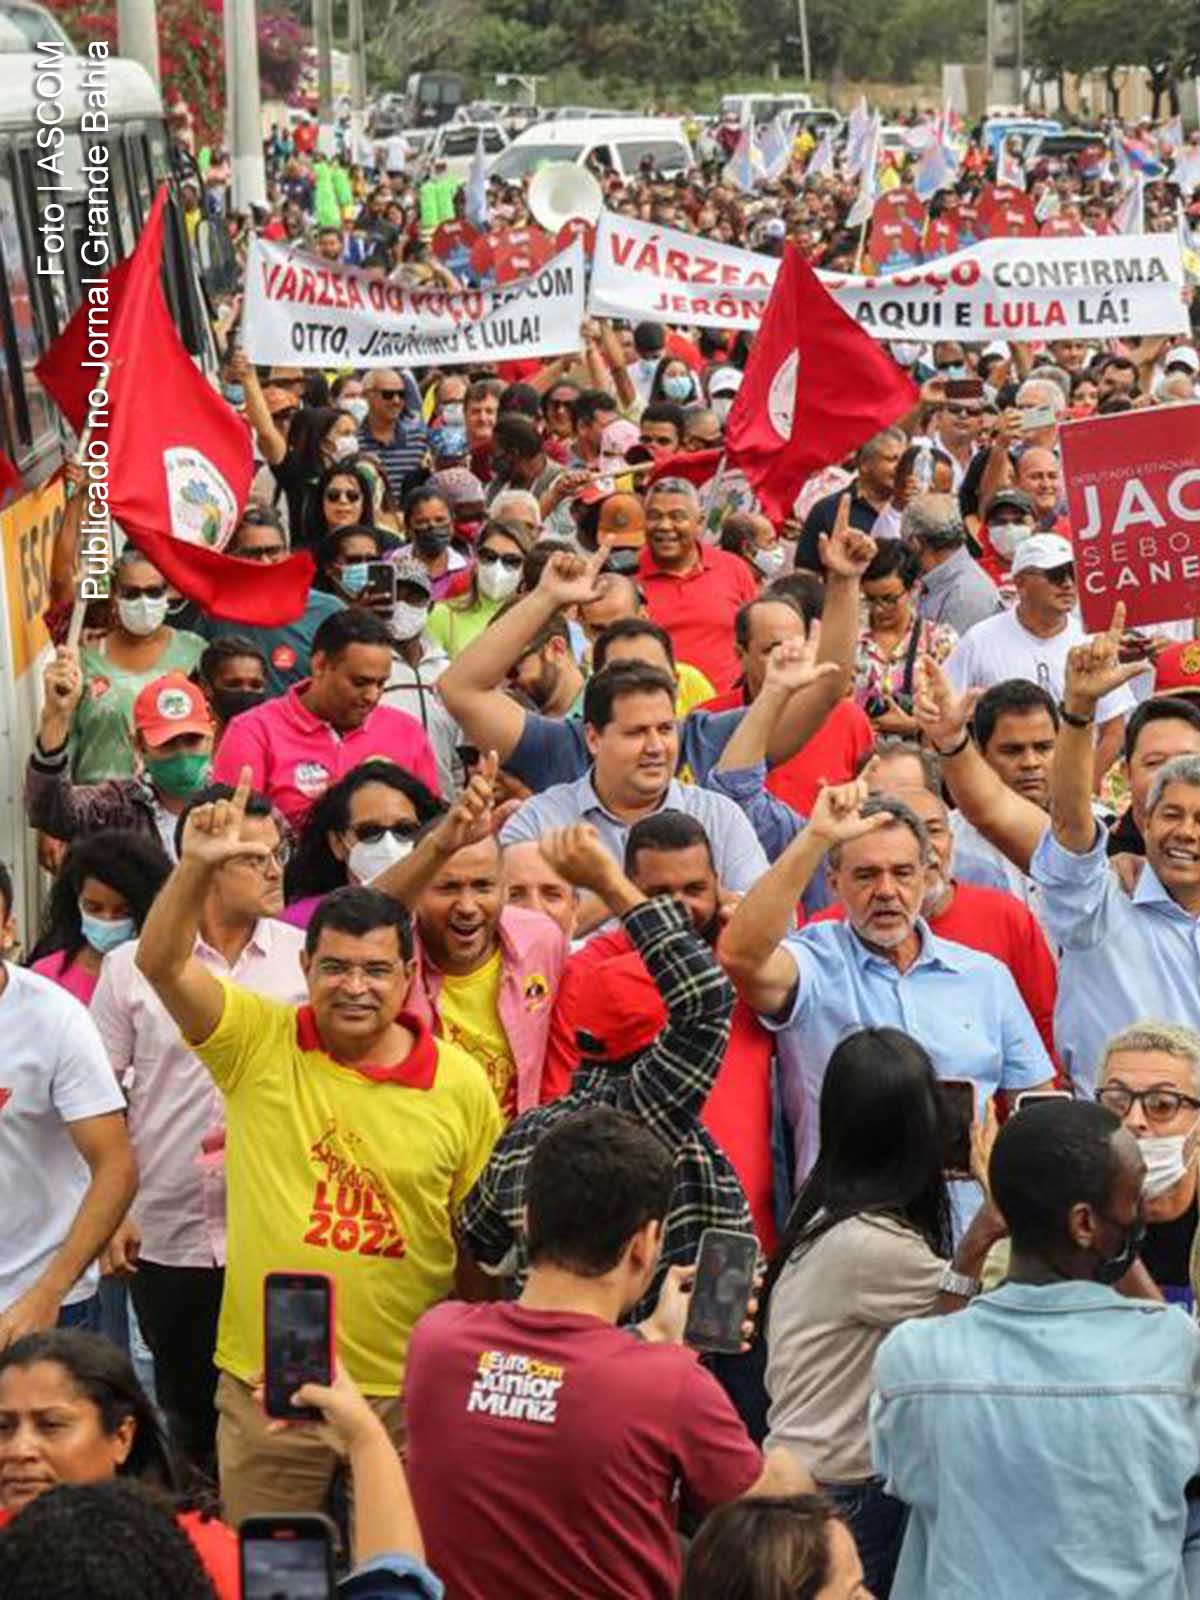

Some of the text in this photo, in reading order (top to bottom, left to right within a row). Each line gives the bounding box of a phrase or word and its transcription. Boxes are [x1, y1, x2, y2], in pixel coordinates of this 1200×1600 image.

[993, 258, 1170, 288] CONFIRMA
[653, 292, 1131, 331] JERÔN AQUI E LULA LÁ!
[291, 321, 350, 358] OTTO,
[480, 316, 541, 350] LULA!
[1082, 531, 1191, 568] SEBO
[466, 1390, 559, 1424] Muniz
